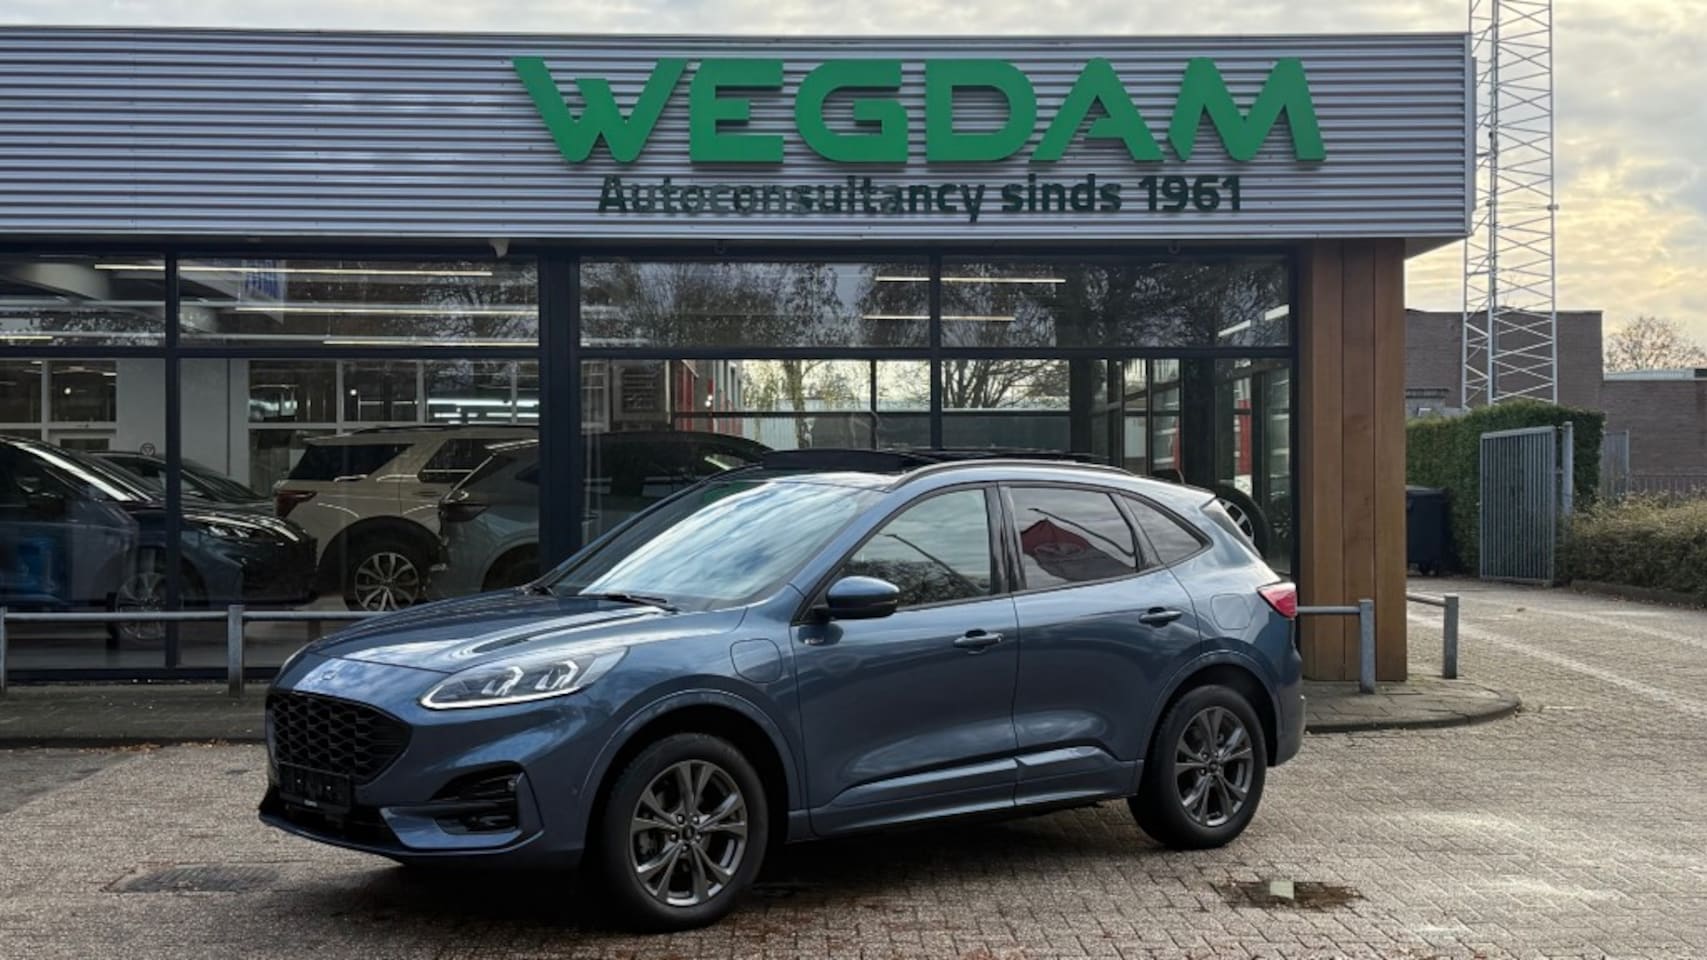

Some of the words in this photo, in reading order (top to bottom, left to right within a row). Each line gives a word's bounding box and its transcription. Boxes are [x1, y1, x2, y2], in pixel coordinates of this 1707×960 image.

[511, 56, 1327, 163] WEGDAM
[598, 174, 986, 224] Autoconsultancy
[1001, 173, 1122, 213] sinds
[1138, 174, 1241, 213] 1961
